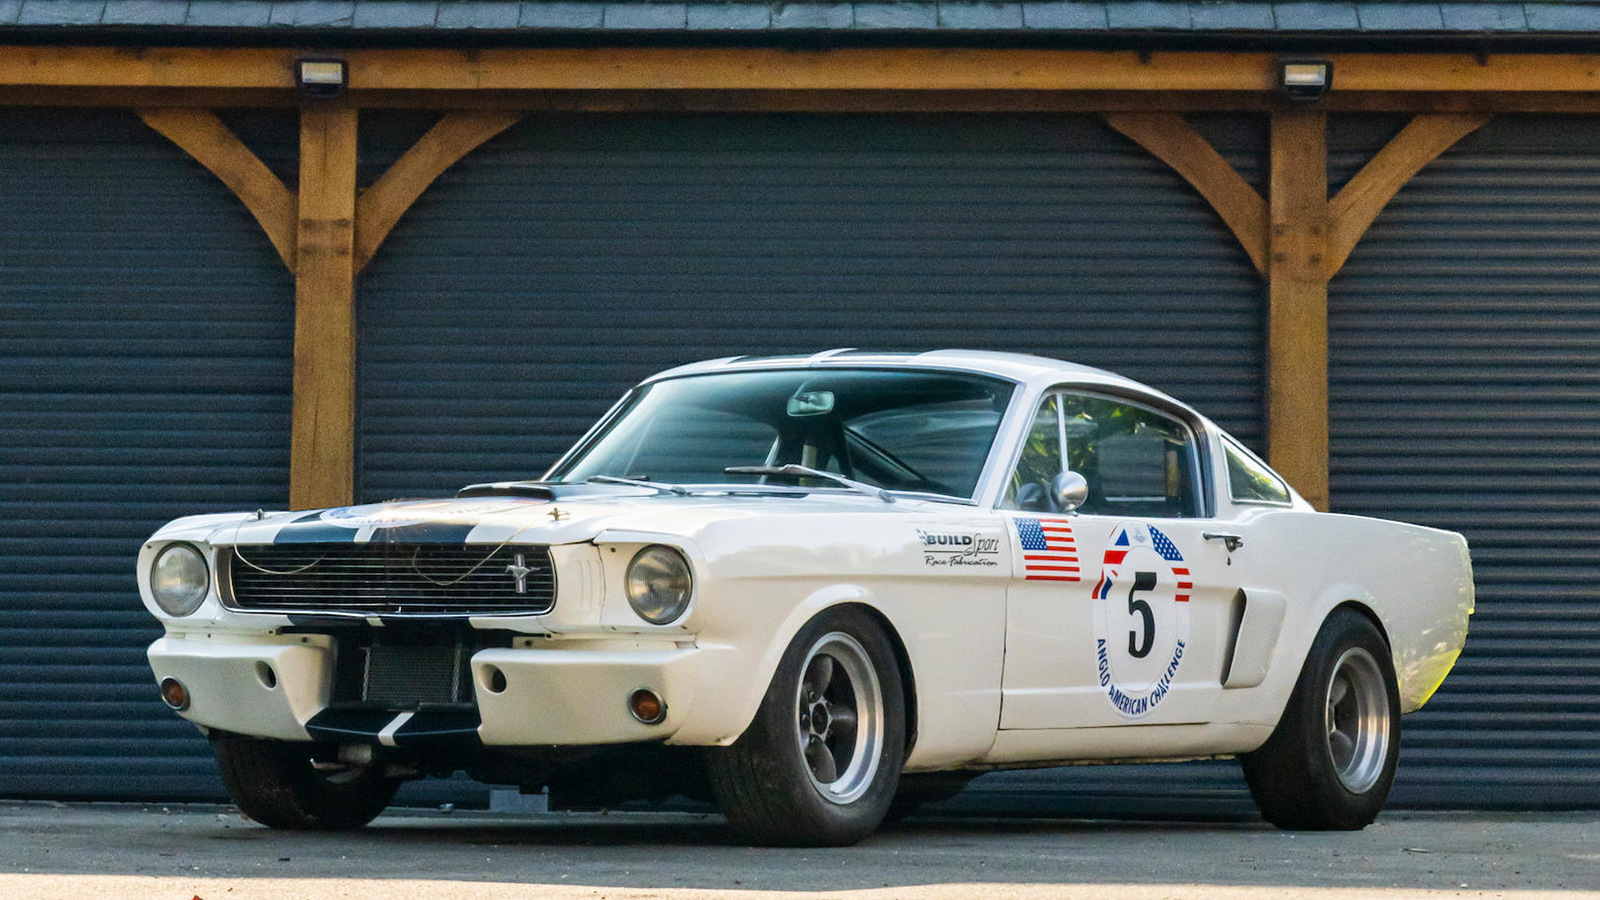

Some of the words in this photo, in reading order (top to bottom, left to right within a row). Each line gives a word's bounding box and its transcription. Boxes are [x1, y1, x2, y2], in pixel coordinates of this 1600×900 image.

[924, 554, 947, 566] Race
[949, 554, 998, 566] Fabrication
[1128, 571, 1157, 658] 5
[1097, 638, 1110, 687] ANGLO
[1108, 684, 1148, 715] AMERICAN
[1149, 639, 1186, 707] CHALLENGE
